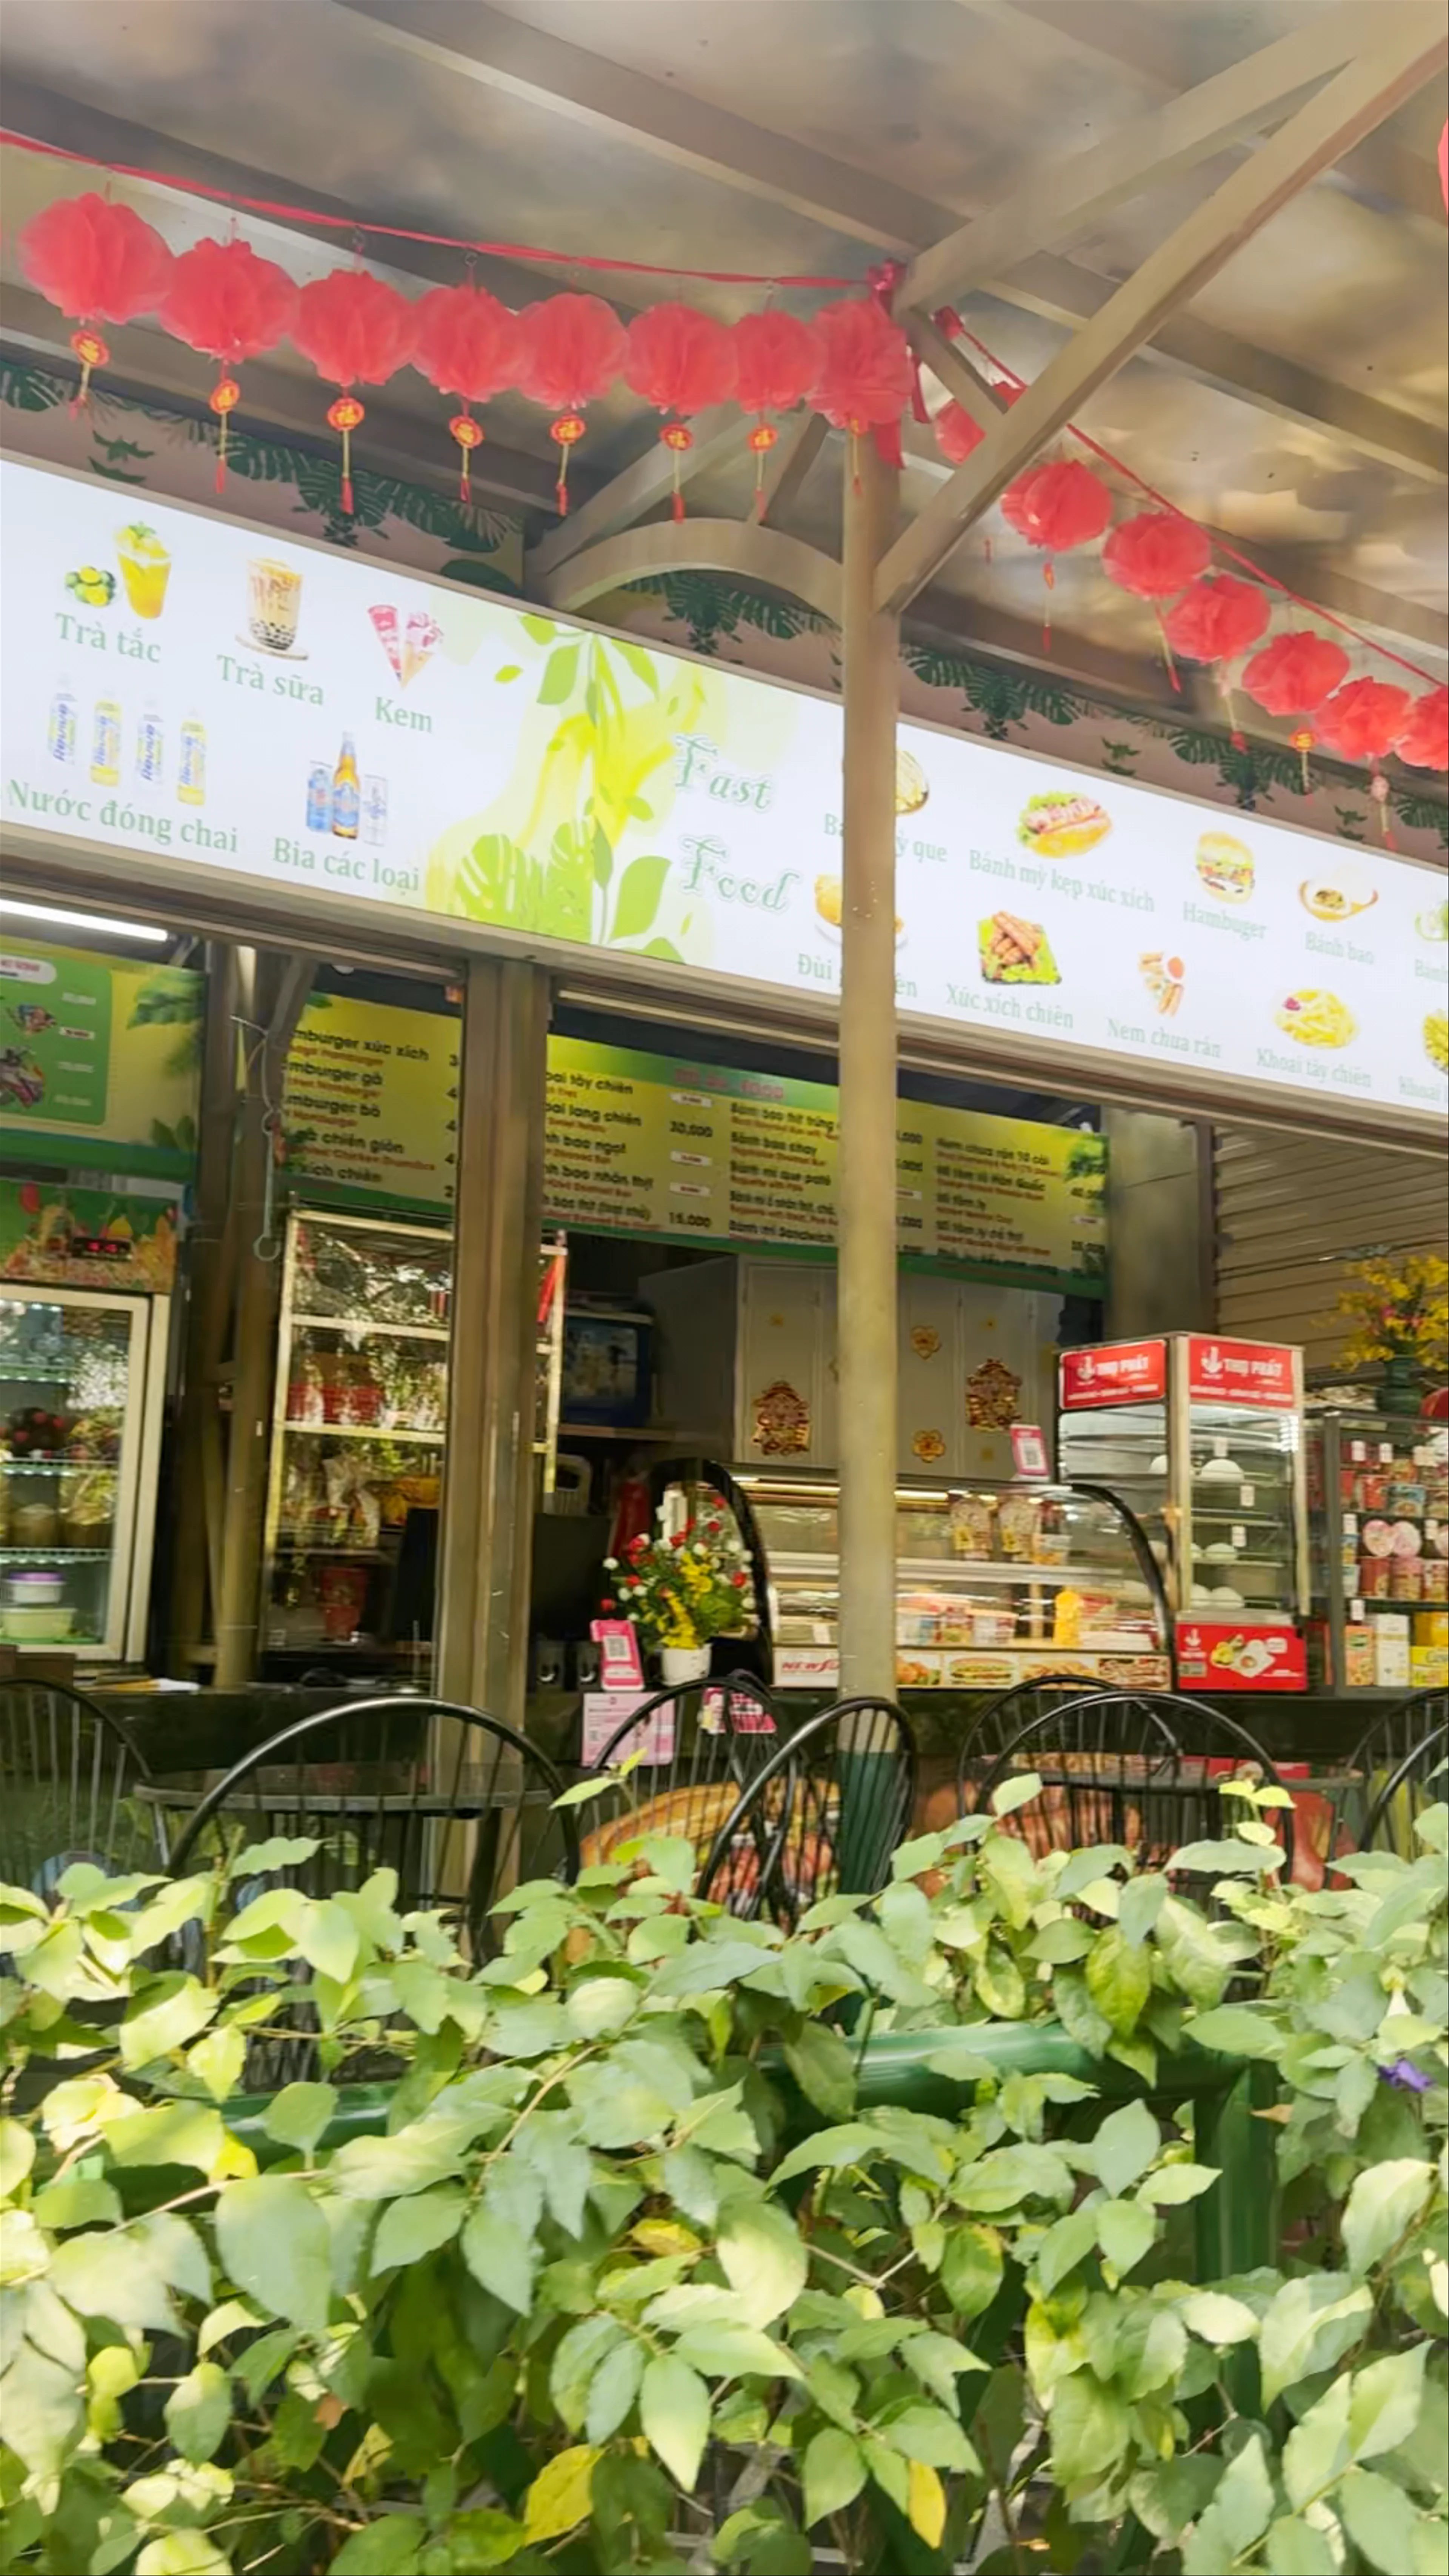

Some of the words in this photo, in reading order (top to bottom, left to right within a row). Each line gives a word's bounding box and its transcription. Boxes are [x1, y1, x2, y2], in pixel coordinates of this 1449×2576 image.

[55, 612, 106, 651] Trà
[117, 628, 161, 663] tắc
[217, 655, 265, 691] Trà
[273, 674, 325, 706] sữa
[375, 697, 433, 734] Kem
[675, 735, 771, 810] Fast
[9, 779, 91, 821] Nước
[100, 800, 172, 845] đóng
[180, 818, 238, 853] chai
[274, 837, 315, 869] Bia
[324, 851, 366, 880] các
[373, 858, 419, 896] loại
[912, 841, 948, 864] que
[681, 836, 800, 911] Food
[969, 849, 1016, 879] Bánh
[1051, 868, 1083, 900] kẹp
[1086, 879, 1116, 903] xúc
[1120, 887, 1155, 912] xích
[1306, 931, 1343, 957] Bánh
[1347, 941, 1374, 965] bao
[798, 953, 832, 980] Đùi
[947, 983, 980, 1009] Xúc
[983, 993, 1020, 1018] xích
[1026, 1001, 1073, 1029] chiên
[292, 1030, 360, 1049] mburger
[1108, 1018, 1145, 1043] Nem
[1151, 1026, 1189, 1051] chua
[289, 1061, 358, 1081] mburger
[546, 1071, 567, 1083] oai
[286, 1095, 357, 1115] mburger
[545, 1101, 566, 1114] oai
